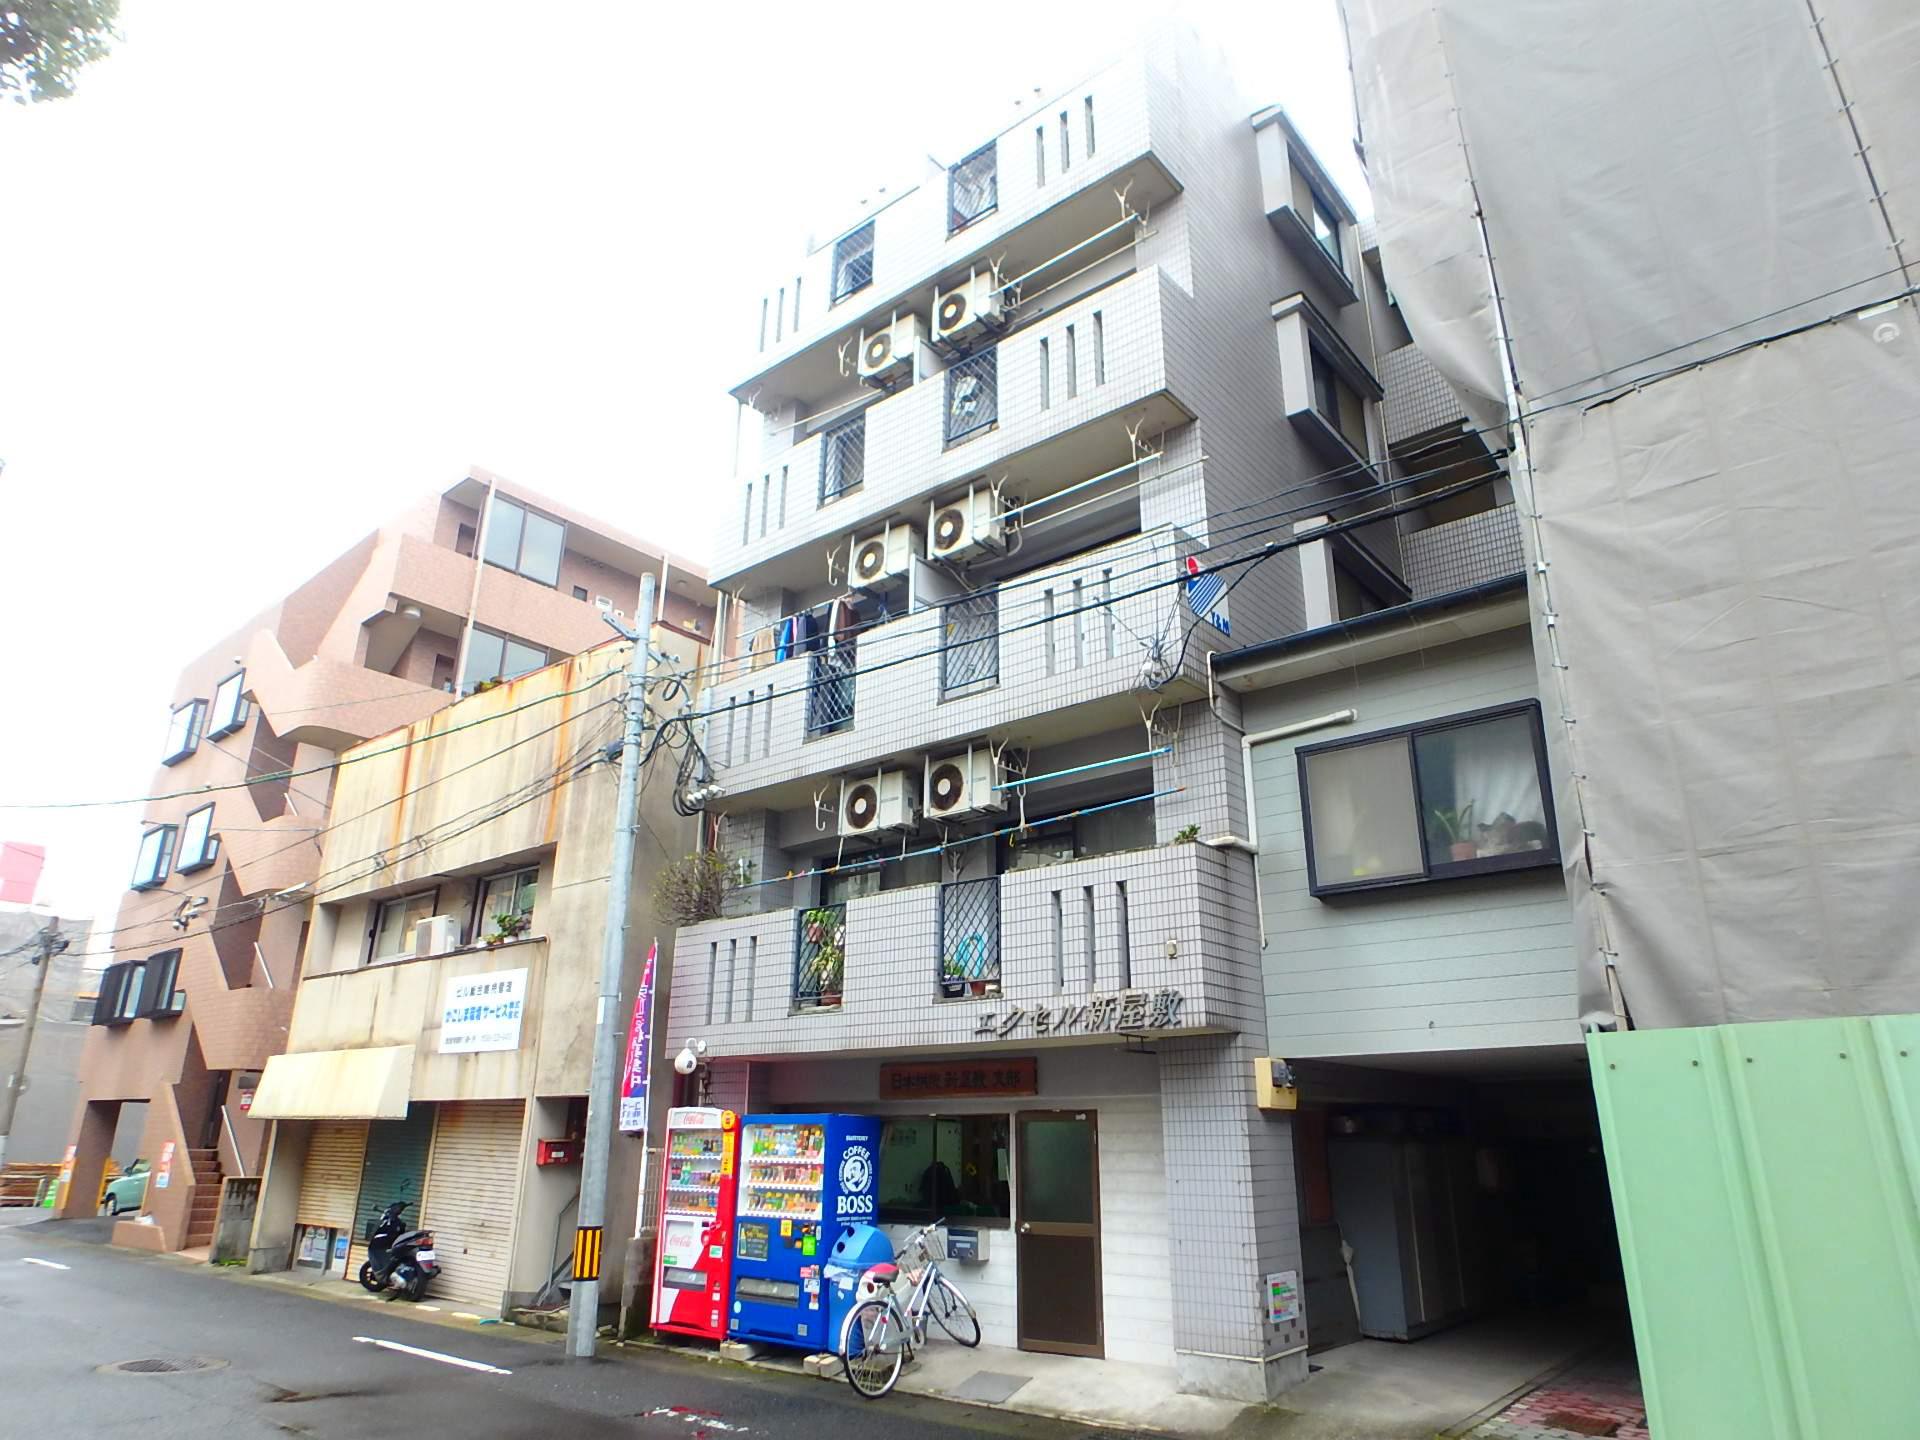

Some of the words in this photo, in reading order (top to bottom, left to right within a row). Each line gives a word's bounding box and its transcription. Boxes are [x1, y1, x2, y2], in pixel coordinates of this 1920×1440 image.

[974, 987, 1185, 1037] エクセル新屋敷
[843, 1145, 870, 1160] COFFEE
[836, 1194, 873, 1214] BOSS
